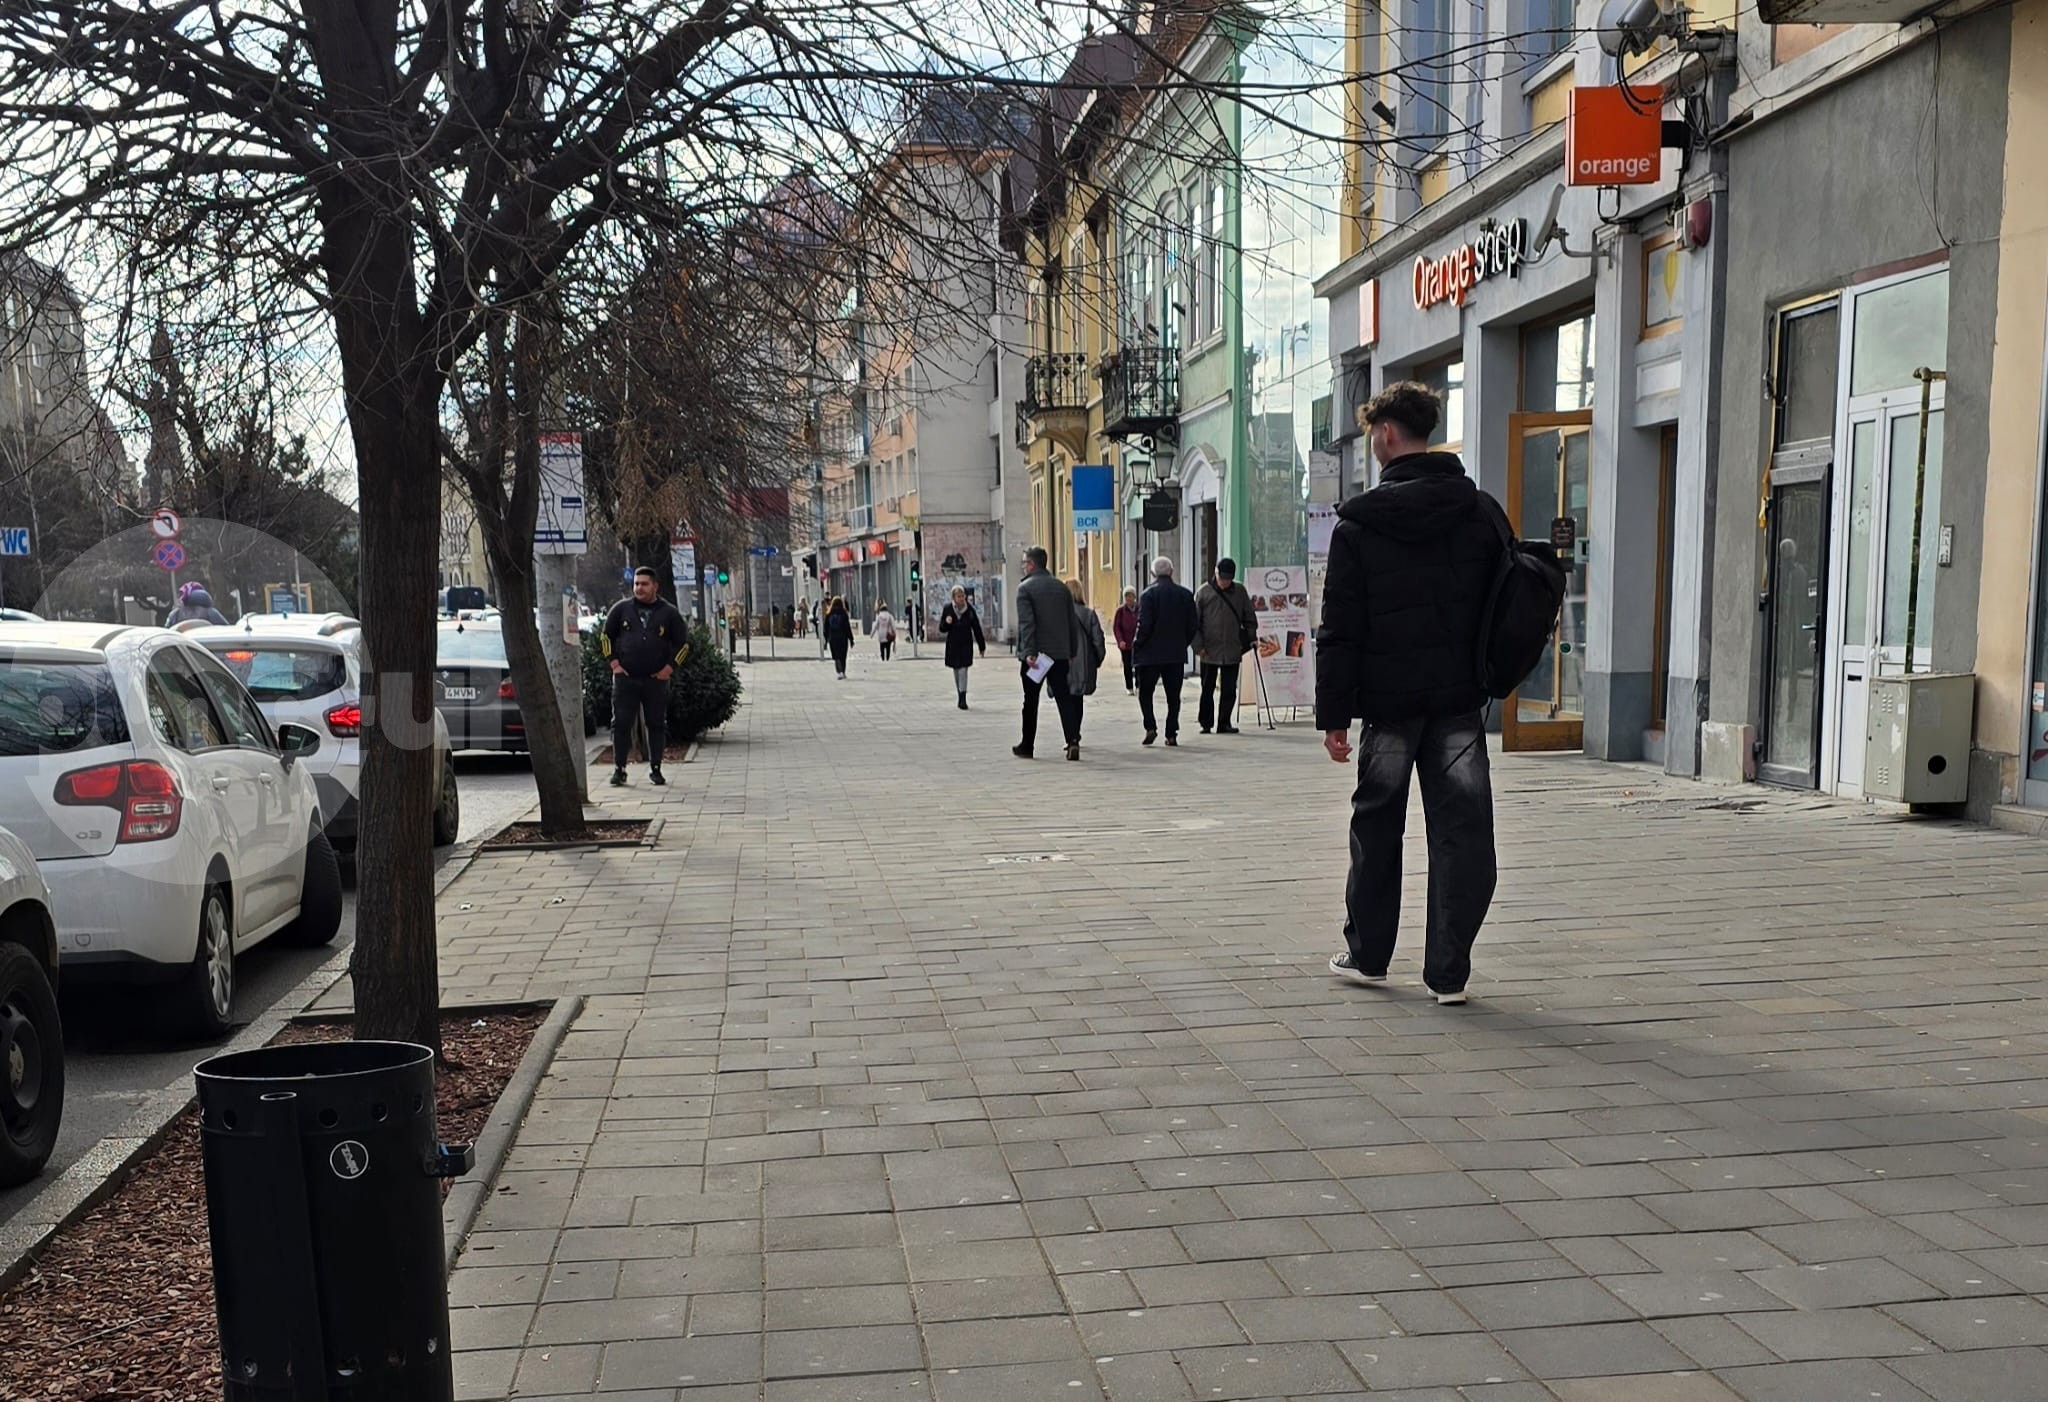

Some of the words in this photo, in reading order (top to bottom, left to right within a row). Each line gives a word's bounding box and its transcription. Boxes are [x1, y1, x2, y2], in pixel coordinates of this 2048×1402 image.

[1579, 157, 1651, 178] orange
[1412, 242, 1473, 312] Orange
[1473, 217, 1525, 283] shop
[1077, 516, 1099, 528] BCR
[1, 528, 28, 554] WC
